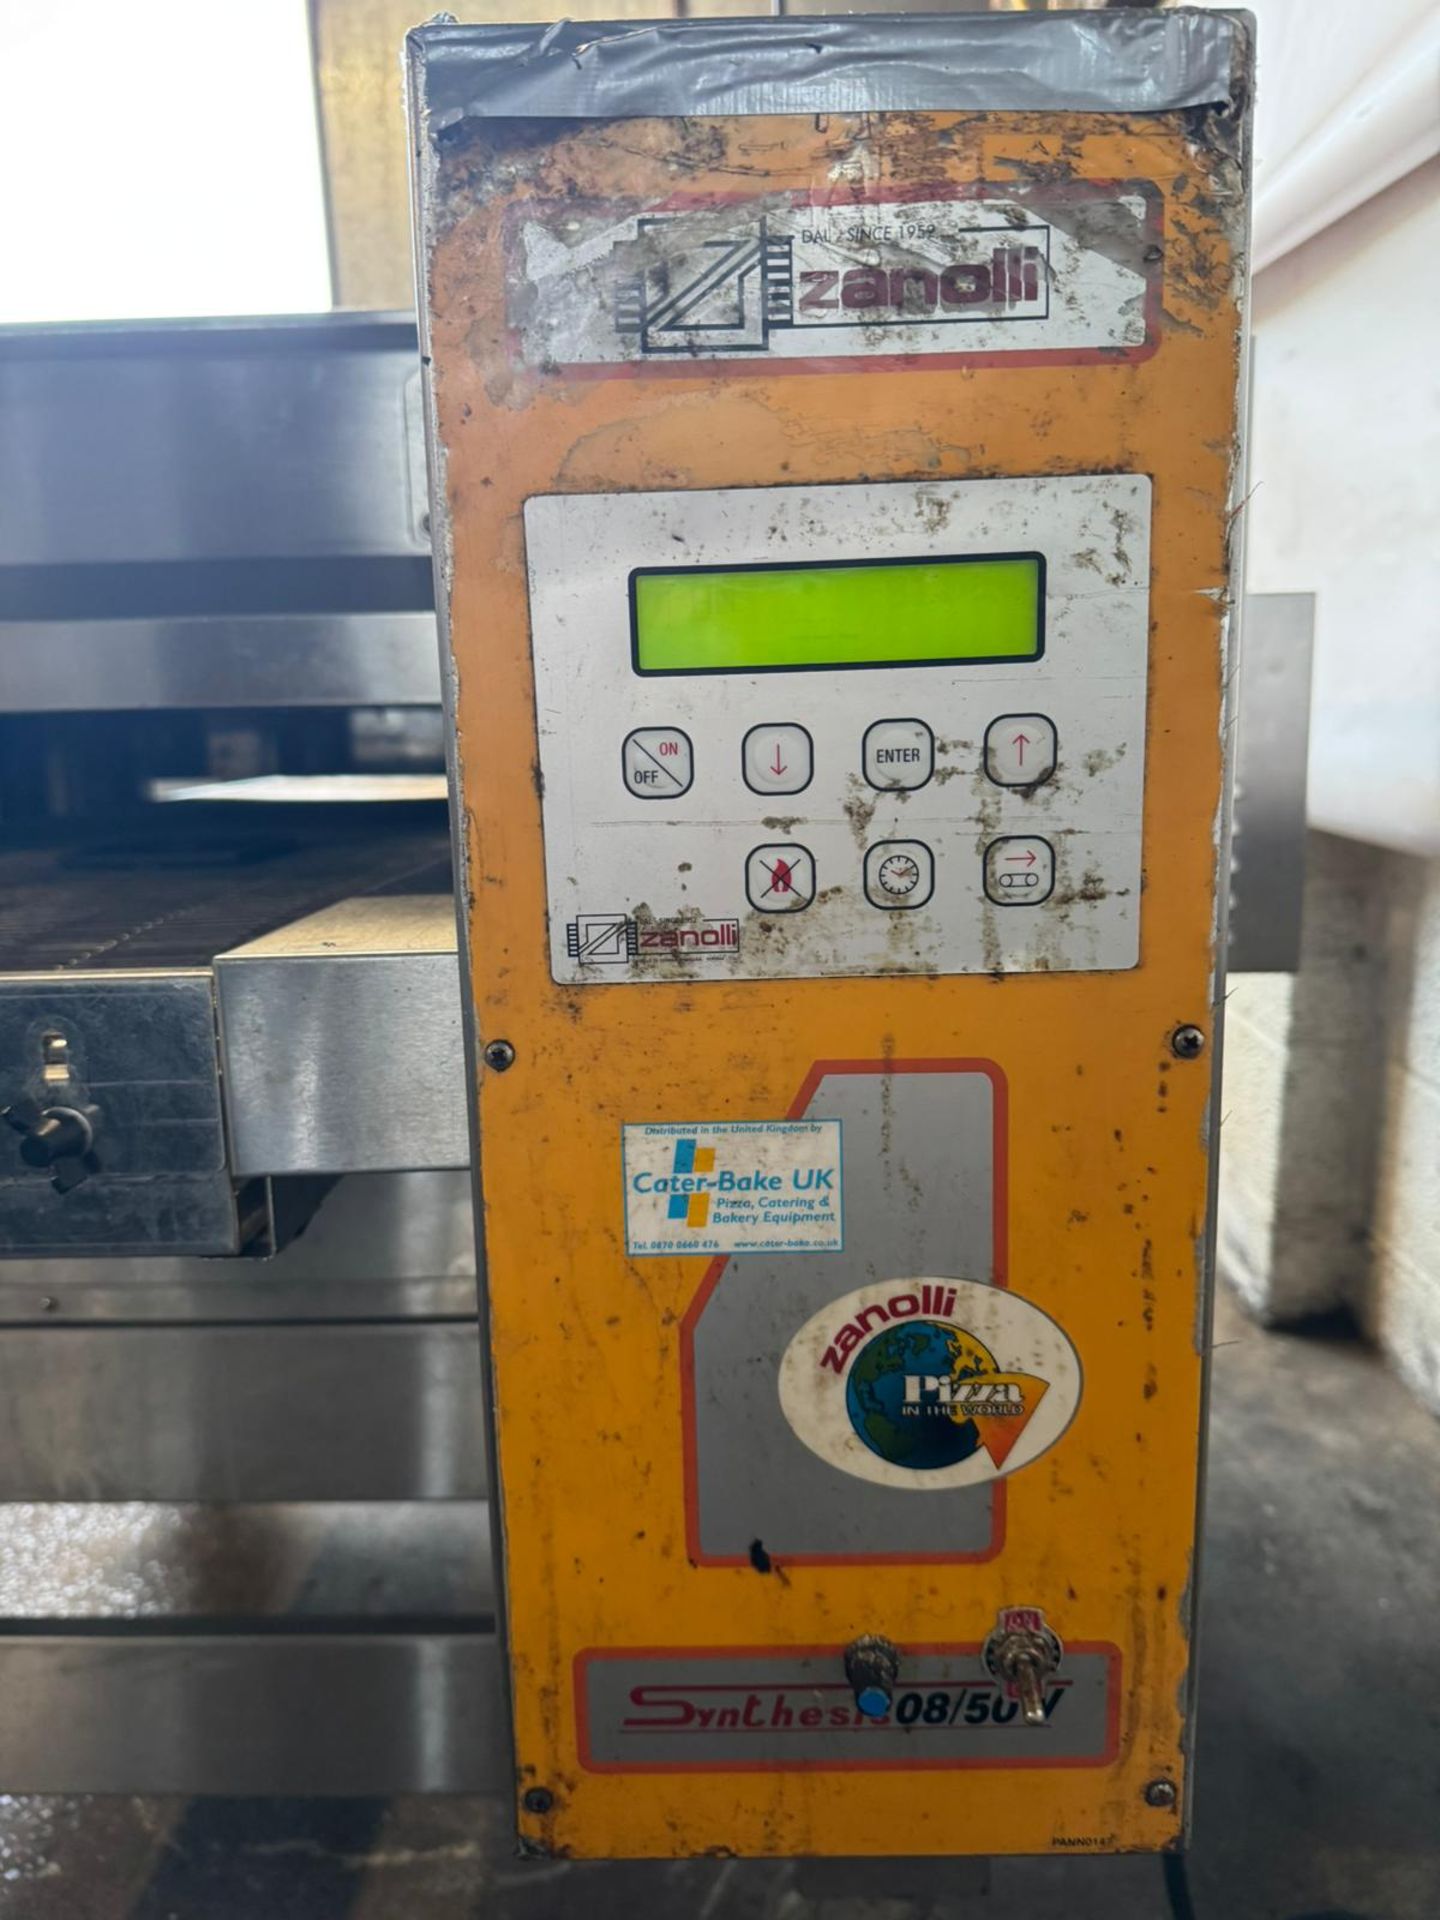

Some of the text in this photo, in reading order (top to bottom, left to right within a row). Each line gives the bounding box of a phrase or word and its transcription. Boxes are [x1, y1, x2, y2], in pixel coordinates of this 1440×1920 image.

[846, 225, 892, 242] SINCE
[799, 246, 1039, 309] zanolli
[659, 742, 679, 756] ON
[876, 748, 921, 764] ENTER
[634, 770, 659, 785] OFF
[640, 924, 738, 948] zanolli
[645, 1124, 822, 1135] Distributed in the United Kingdom by
[633, 1169, 834, 1194] Cater-Bake UK
[716, 1196, 829, 1210] Pizza, Catering &
[713, 1211, 835, 1225] Bakery Equipment
[820, 1285, 957, 1374] zanolli
[904, 1375, 1025, 1404] Pizza
[902, 1404, 1024, 1416] IN THE WORLD
[624, 1685, 892, 1727] Synthes
